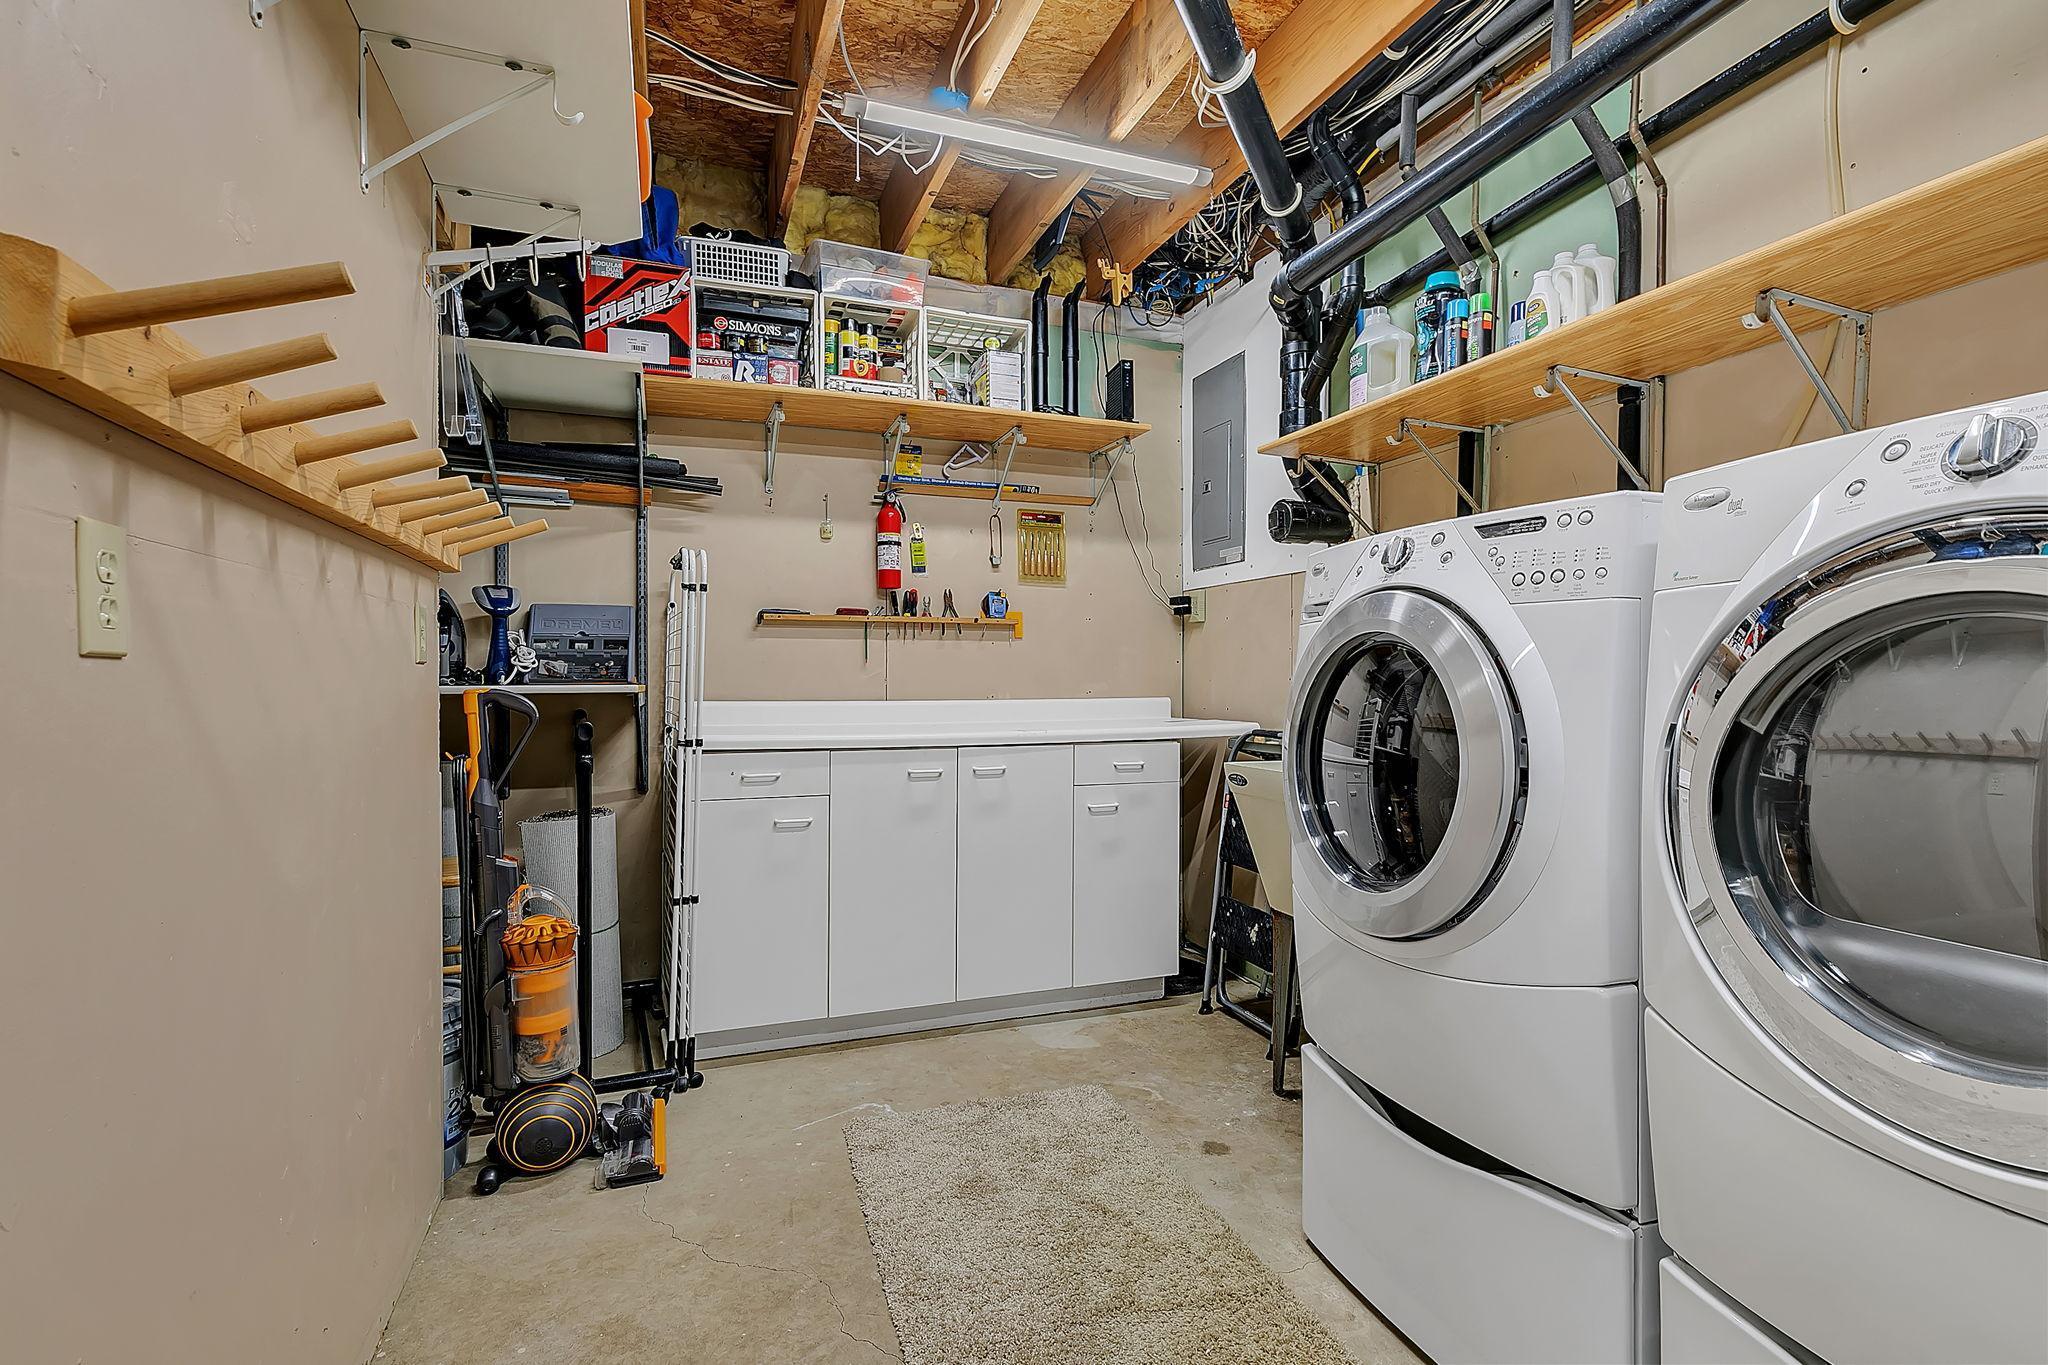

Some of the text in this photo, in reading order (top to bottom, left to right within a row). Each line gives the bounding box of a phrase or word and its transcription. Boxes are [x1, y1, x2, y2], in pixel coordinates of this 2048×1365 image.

[591, 260, 623, 269] MODULAR
[605, 266, 623, 274] DUAL
[600, 271, 624, 279] SPORT
[626, 299, 673, 323] CX950
[728, 320, 782, 336] SIMMONS
[698, 357, 731, 367] ESTATE
[734, 360, 756, 383] R
[1935, 430, 1957, 438] CASUAL
[1919, 442, 1944, 451] DELICATE
[1920, 451, 1937, 459] SUPER
[1911, 458, 1937, 466] DELICATE
[1923, 488, 1941, 496] QUICK
[541, 617, 624, 631] DREMEL
